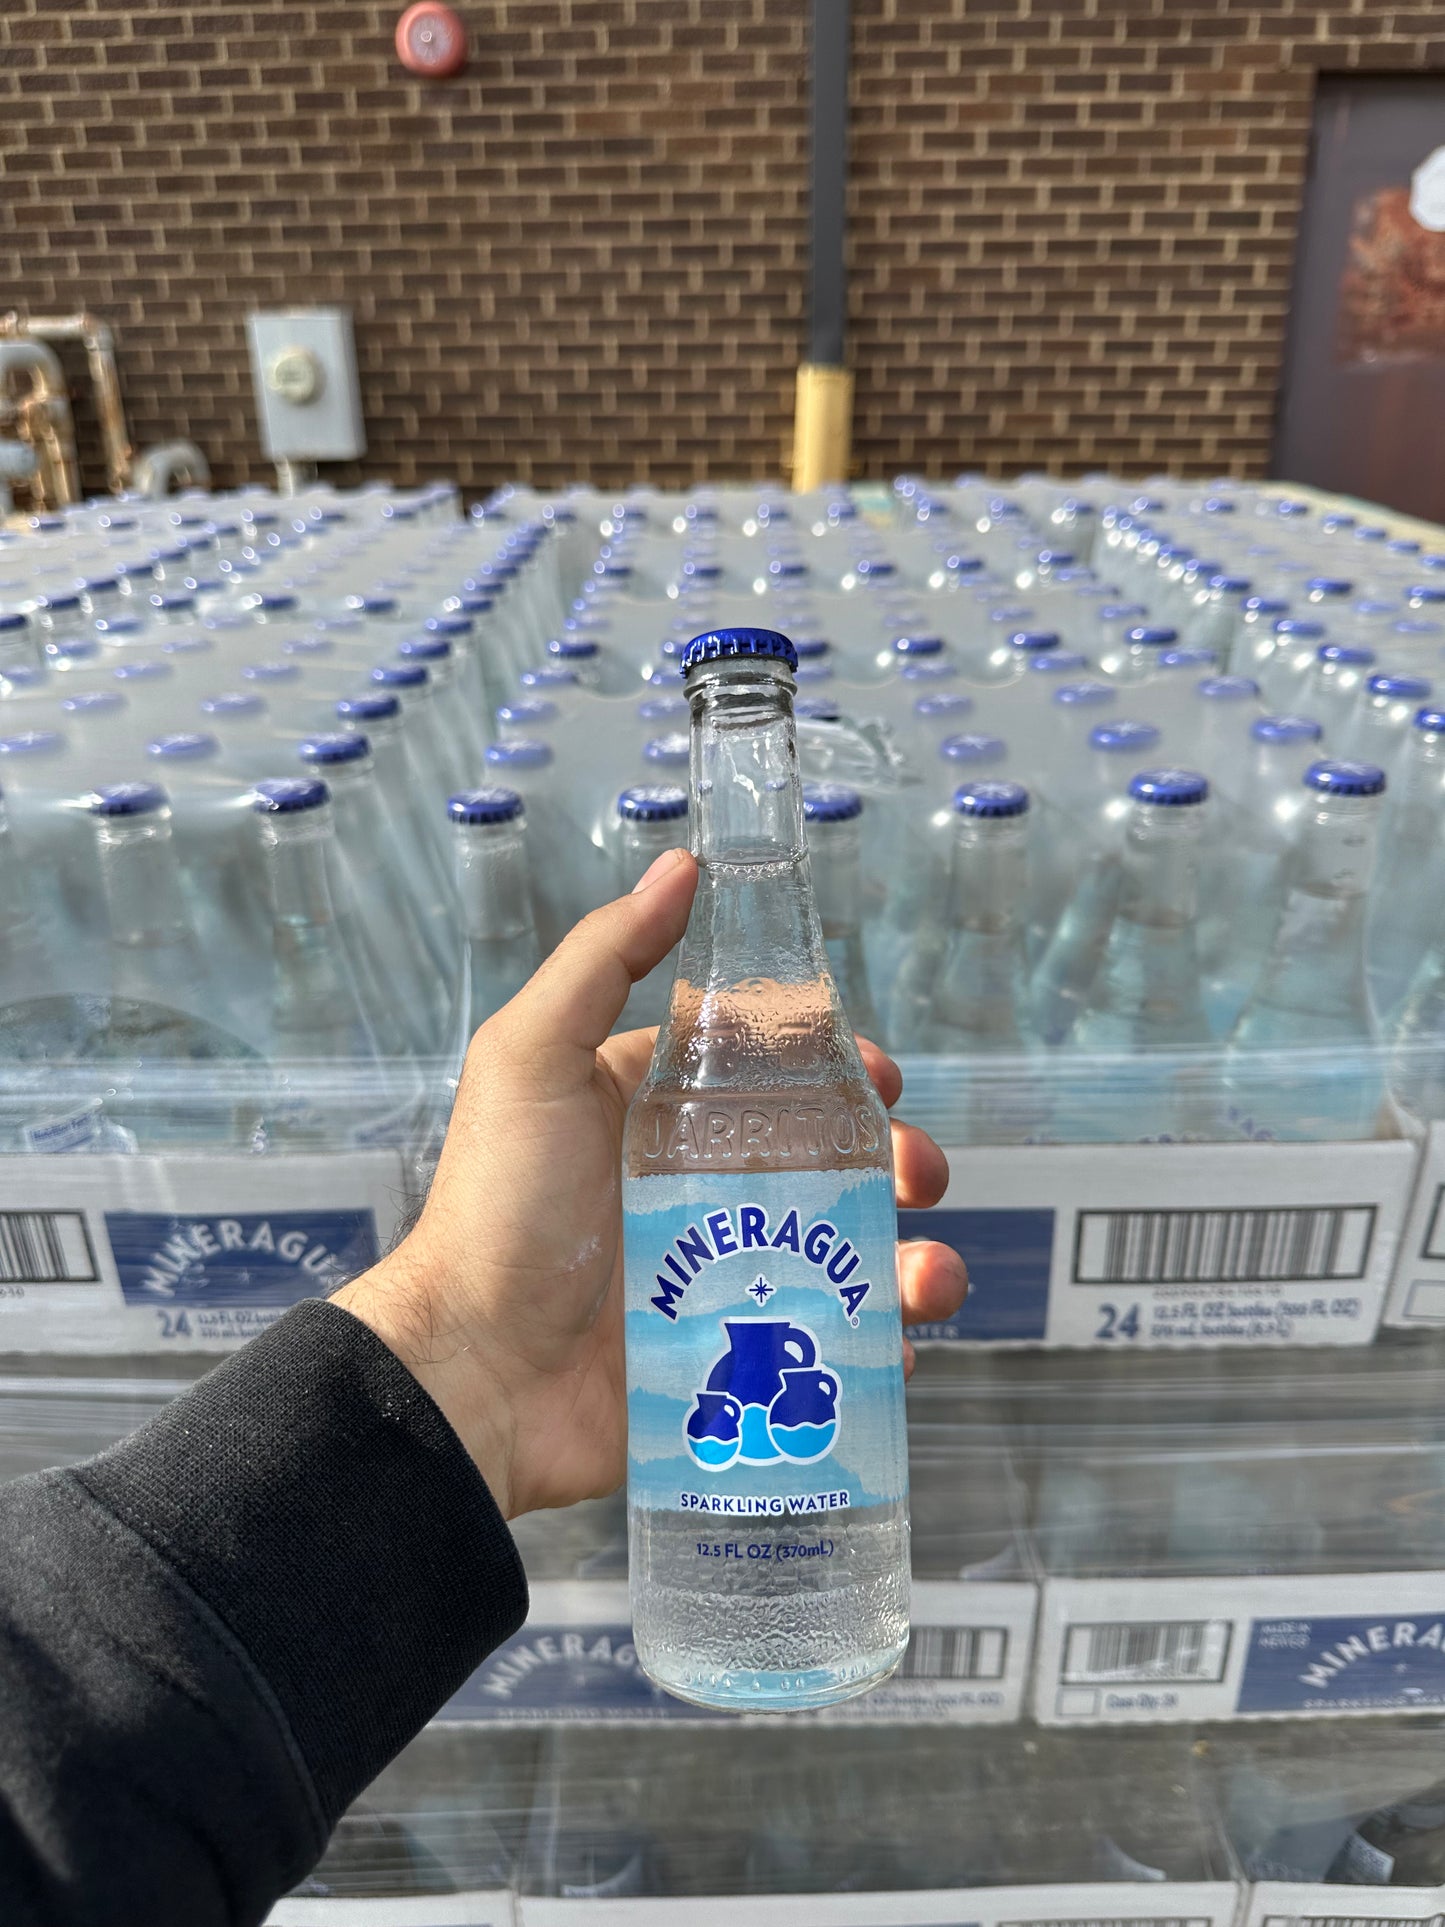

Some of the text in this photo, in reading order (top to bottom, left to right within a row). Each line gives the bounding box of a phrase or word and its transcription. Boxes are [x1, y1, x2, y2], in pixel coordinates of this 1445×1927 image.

[644, 1103, 881, 1159] JARRITOS
[650, 1206, 871, 1321] MINERAGUA
[157, 1309, 193, 1337] 24
[1095, 1303, 1140, 1338] 24
[681, 1491, 849, 1513] SPARKLING WATER
[697, 1539, 834, 1563] 12.5 FL OZ (370mL)
[1299, 1621, 1445, 1689] MINERA
